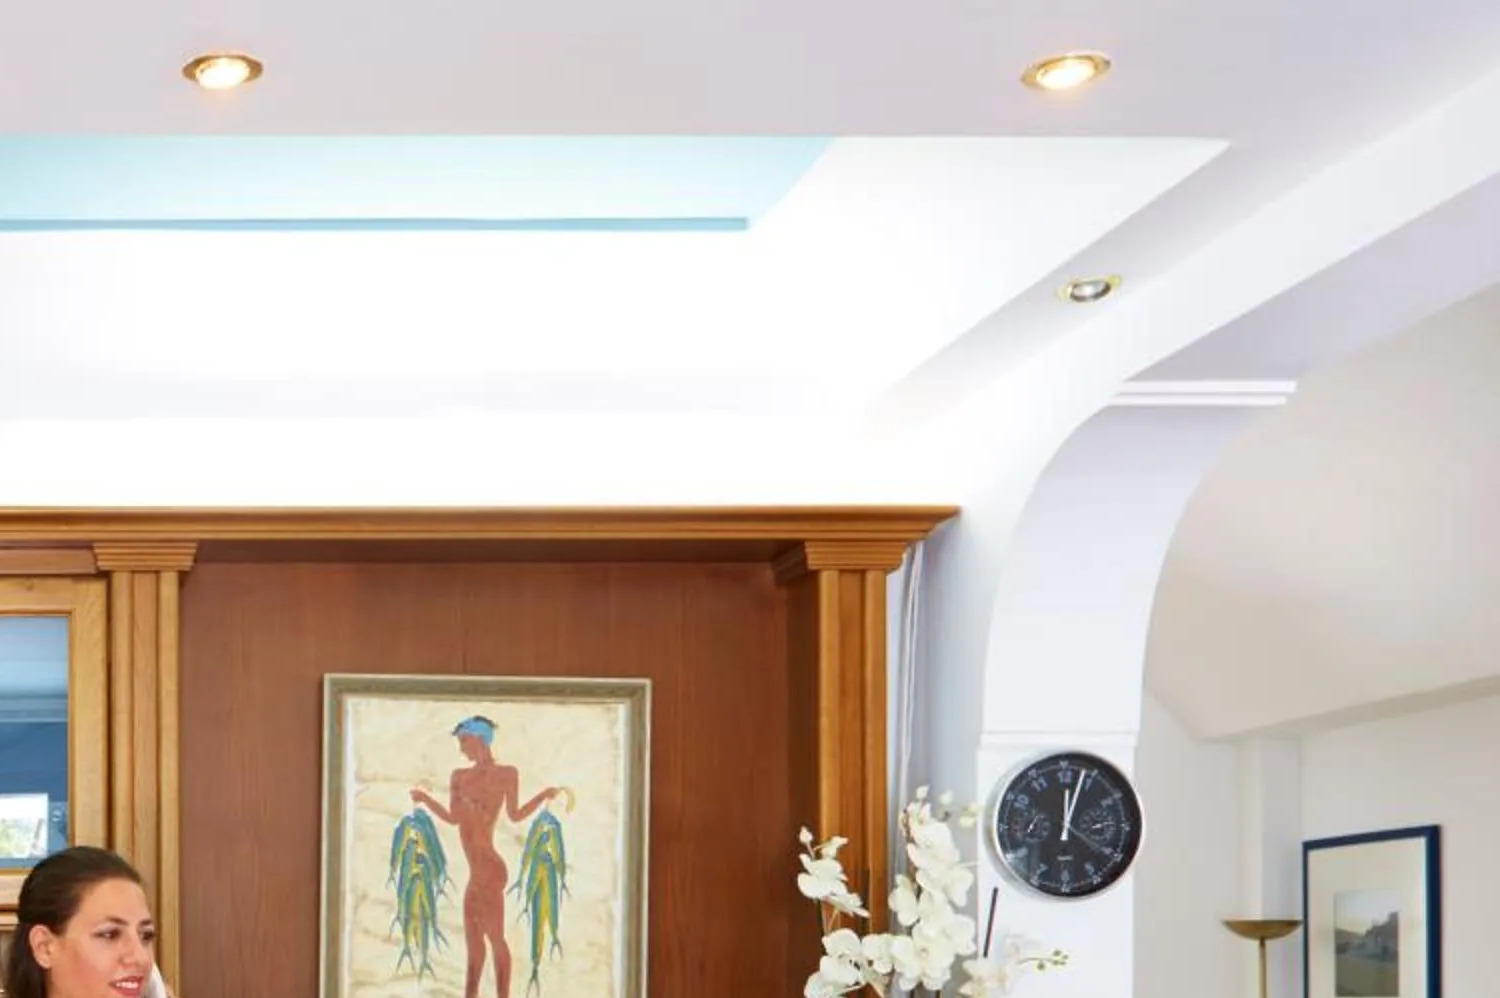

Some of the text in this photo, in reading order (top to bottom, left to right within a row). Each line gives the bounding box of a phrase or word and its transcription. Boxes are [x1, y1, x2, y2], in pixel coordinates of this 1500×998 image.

[1031, 776, 1048, 792] 11
[1057, 770, 1073, 784] 12
[1013, 794, 1029, 810] 10
